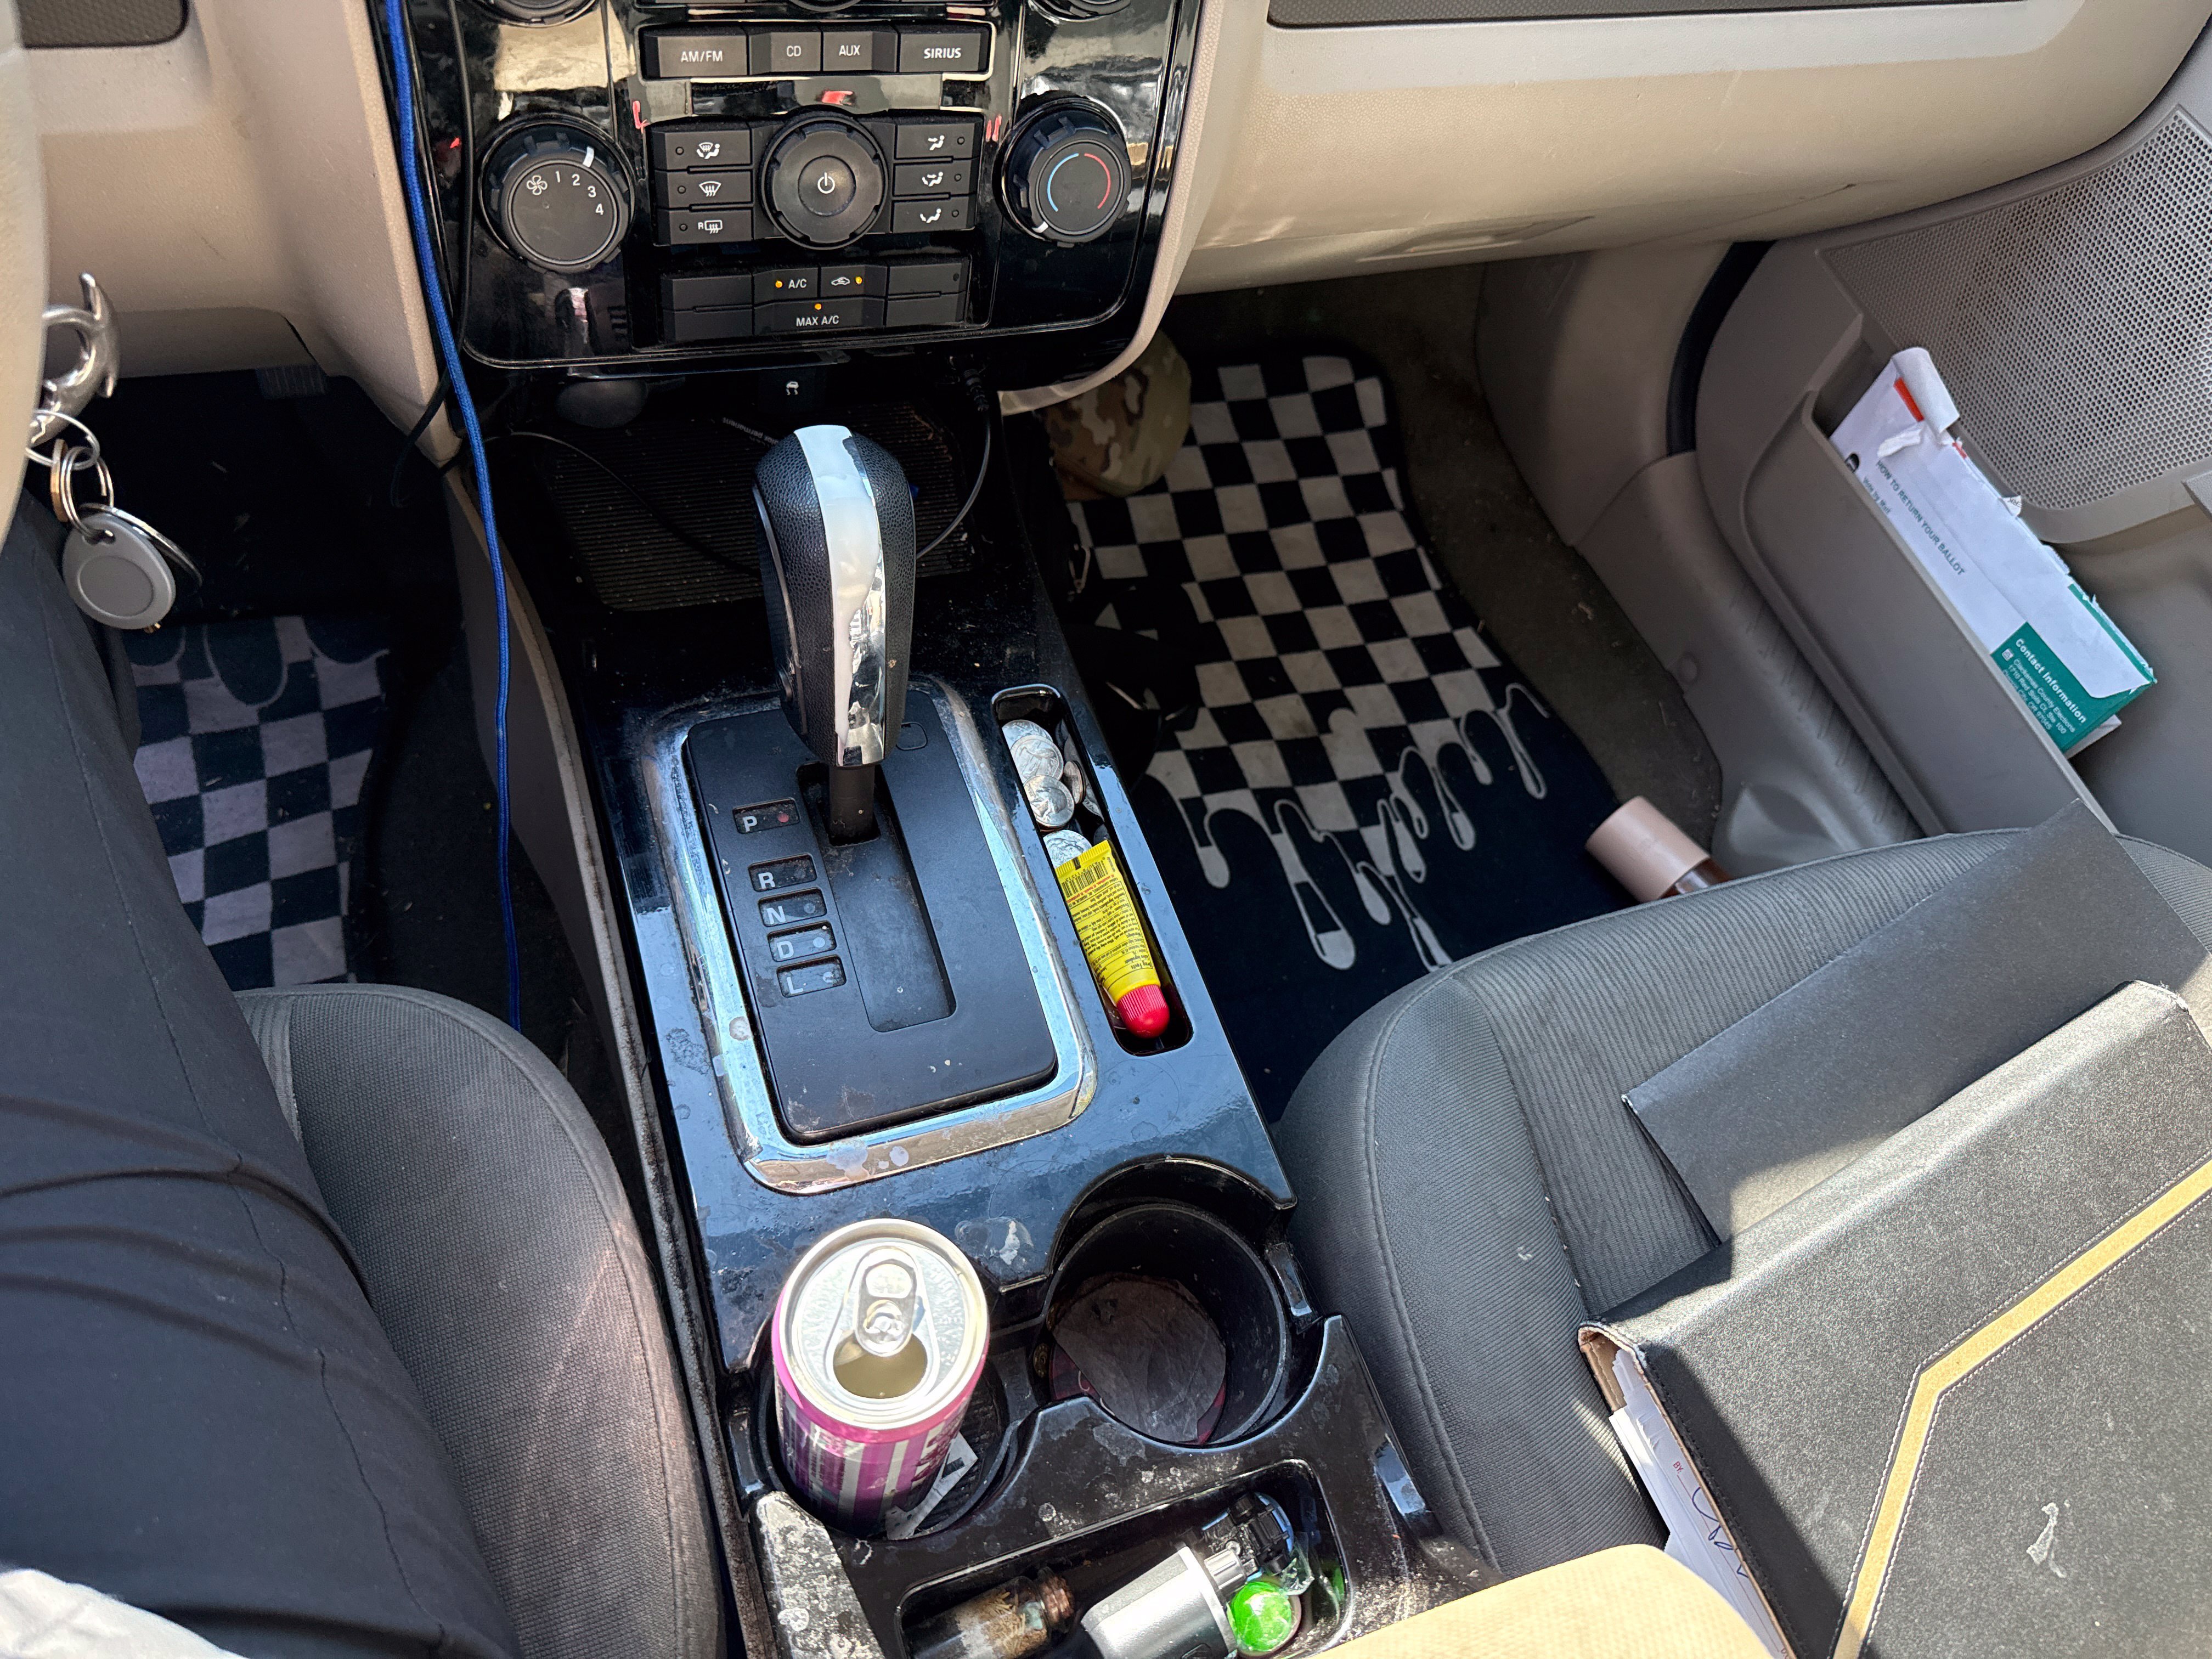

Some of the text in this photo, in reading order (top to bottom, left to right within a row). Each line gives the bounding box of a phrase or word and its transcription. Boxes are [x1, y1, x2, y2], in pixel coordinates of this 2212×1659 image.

[680, 50, 723, 63] AM/FM
[786, 45, 802, 57] CD
[838, 45, 861, 57] AUX
[923, 47, 962, 59] SIRIUS
[555, 171, 604, 216] 1 2 3 4
[788, 278, 807, 290] A/C
[796, 314, 839, 326] MAX A/C
[1876, 460, 1965, 575] HOW TO RETURN YOUR BALLOT
[2016, 638, 2086, 723] Contact Information
[2013, 659, 2075, 733] Clackamas County Elections
[2018, 678, 2030, 691] Red
[2056, 723, 2067, 734] 100
[2028, 701, 2038, 712] OR
[2036, 711, 2052, 730] 97045
[742, 815, 758, 833] P
[758, 872, 776, 890] R
[766, 905, 786, 925] N
[776, 940, 794, 960] D
[787, 977, 804, 995] L
[1673, 1461, 1683, 1474] BY:
